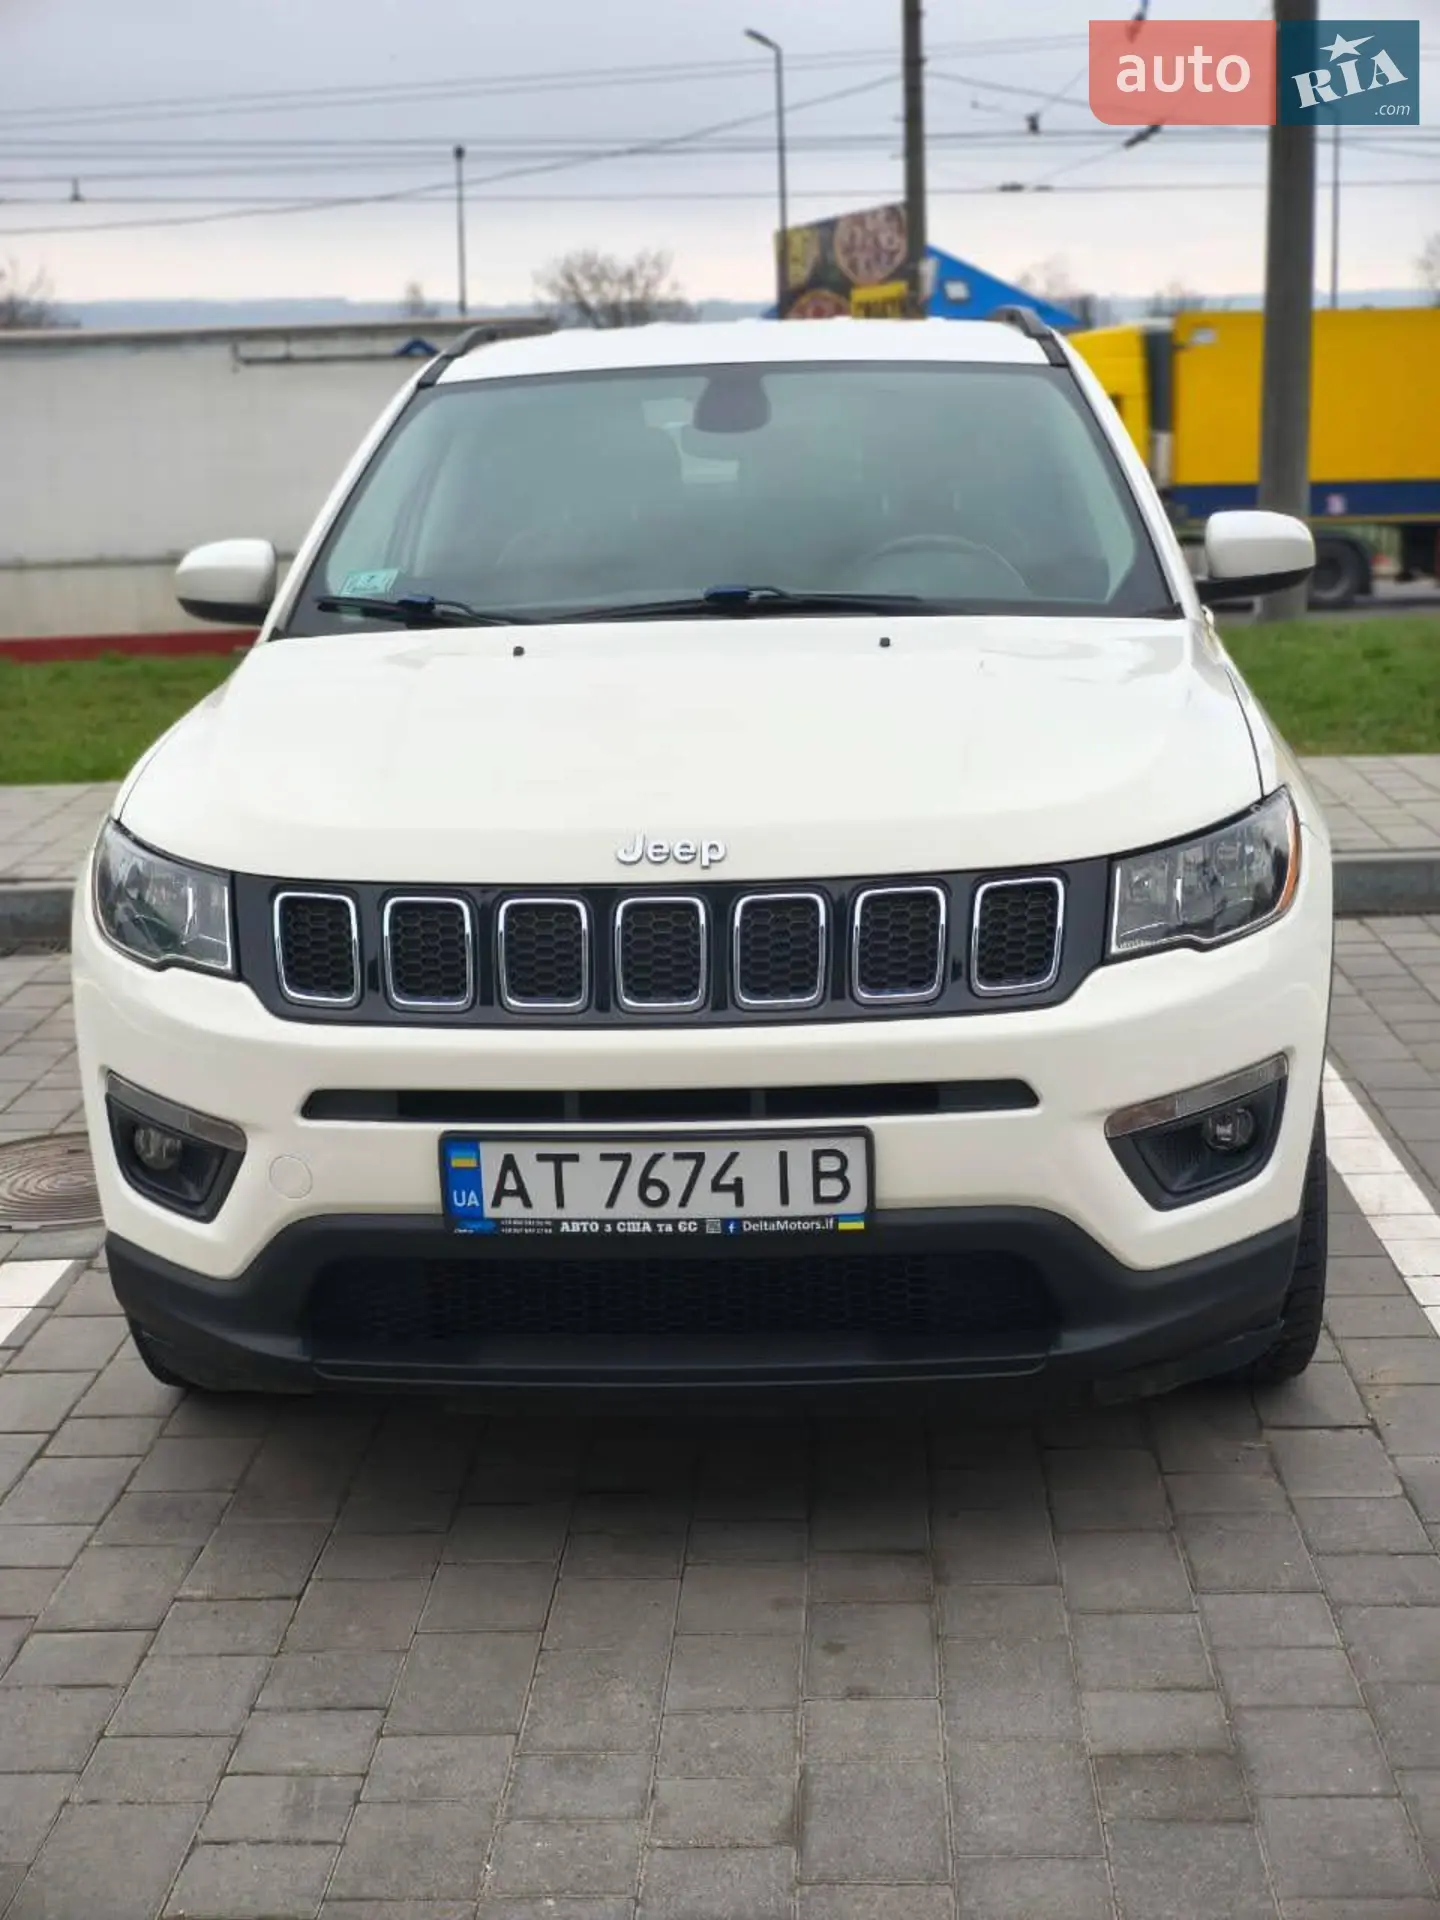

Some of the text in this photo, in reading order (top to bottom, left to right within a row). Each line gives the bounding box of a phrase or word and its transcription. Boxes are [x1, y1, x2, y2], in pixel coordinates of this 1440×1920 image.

[616, 831, 727, 870] Jeep
[491, 1148, 851, 1209] AT 7674 IB
[452, 1190, 480, 1207] UA
[560, 1221, 600, 1233] АВТО
[616, 1221, 652, 1233] США
[656, 1223, 673, 1233] та
